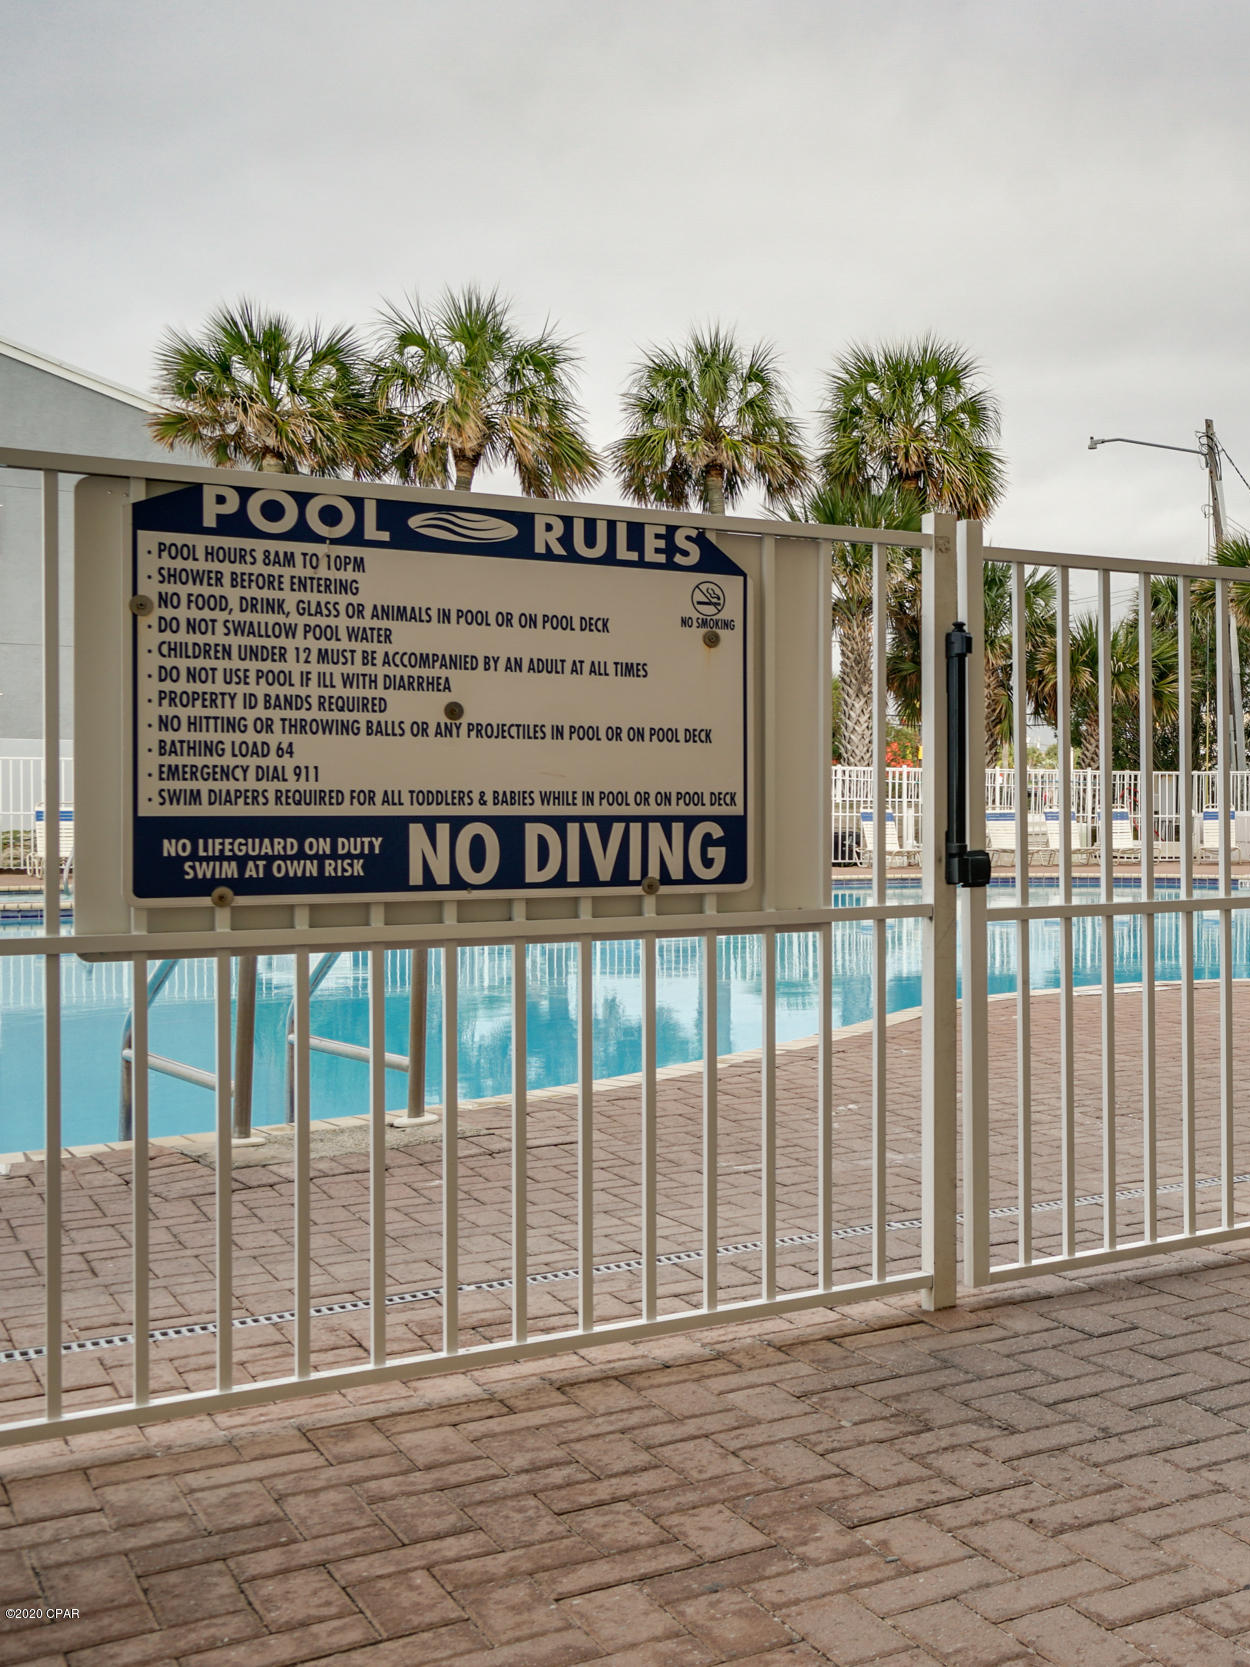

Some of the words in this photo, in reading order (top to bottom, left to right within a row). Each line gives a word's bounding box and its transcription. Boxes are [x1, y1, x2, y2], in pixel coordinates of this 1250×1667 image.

[203, 484, 391, 541] POOL
[534, 513, 702, 566] RULES
[158, 542, 199, 561] POOL
[205, 545, 256, 565] HOURS
[263, 550, 295, 568] 8AM
[301, 552, 319, 570] TO
[326, 555, 365, 573] 10PM
[158, 567, 223, 588] SHOWER
[231, 571, 284, 591] BEFORE
[290, 576, 359, 595] ENTERING
[158, 591, 181, 609] NO
[187, 593, 232, 615] FOOD,
[240, 597, 290, 618] DRINK,
[296, 600, 340, 618] GLASS
[346, 603, 364, 619] OR
[371, 604, 432, 623] ANIMALS
[438, 608, 450, 624] IN
[457, 610, 490, 626] POOL
[496, 612, 513, 628] OR
[519, 613, 537, 629] ON
[543, 614, 575, 631] POOL
[580, 616, 609, 633] DECK
[681, 616, 694, 629] NO
[696, 617, 736, 632] SMOKING
[158, 616, 180, 634] DO
[187, 618, 217, 635] NOT
[223, 619, 297, 639] SWALLOW
[304, 624, 341, 641] POOL
[346, 626, 392, 644] WATER
[158, 641, 232, 660] CHILDREN
[238, 644, 287, 662] UNDER
[295, 647, 311, 663] 12
[317, 649, 356, 666] MUST
[362, 650, 376, 666] BE
[382, 651, 478, 671] ACCOMPANIED
[484, 656, 499, 671] BY
[505, 657, 522, 673] AN
[528, 658, 566, 674] ADULT
[571, 660, 584, 675] AT
[589, 661, 609, 676] ALL
[614, 662, 648, 678] TIMES
[159, 665, 180, 683] DO
[187, 666, 217, 684] NOT
[224, 669, 249, 685] USE
[256, 670, 294, 687] POOL
[301, 671, 311, 687] IF
[318, 672, 336, 688] ILL
[341, 672, 377, 690] WITH
[384, 675, 451, 692] DIARRHEA
[159, 690, 237, 709] PROPERTY
[244, 693, 257, 709] ID
[264, 694, 312, 711] BANDS
[318, 695, 387, 712] REQUIRED
[159, 715, 181, 731] NO
[188, 716, 247, 733] HITTING
[254, 717, 273, 733] OR
[280, 718, 360, 736] THROWING
[367, 720, 405, 736] BALLS
[411, 721, 429, 737] OR
[435, 722, 462, 737] ANY
[468, 723, 546, 739] PROJECTILES
[552, 725, 564, 740] IN
[569, 726, 601, 740] POOL
[606, 727, 622, 741] OR
[628, 727, 644, 741] ON
[650, 727, 680, 743] POOL
[685, 728, 712, 743] DECK
[159, 739, 225, 757] BATHING
[232, 741, 270, 758] LOAD
[276, 742, 294, 758] 64
[159, 764, 249, 782] EMERGENCY
[256, 766, 288, 782] DIAL
[294, 766, 318, 782] 911
[158, 788, 202, 805] SWIM
[208, 789, 268, 806] DIAPERS
[275, 790, 344, 806] REQUIRED
[350, 790, 376, 806] FOR
[382, 790, 404, 805] ALL
[409, 790, 473, 805] TODDLERS
[479, 791, 487, 805] &
[493, 791, 534, 806] BABIES
[540, 791, 577, 806] WHILE
[582, 791, 594, 806] IN
[600, 791, 630, 806] POOL
[634, 792, 650, 806] OR
[655, 792, 671, 806] ON
[676, 792, 705, 806] POOL
[710, 792, 736, 806] DECK
[163, 839, 191, 856] NO
[199, 838, 297, 856] LIFEGUARD
[305, 838, 330, 854] ON
[338, 837, 382, 854] DUTY
[409, 822, 500, 886] NO
[525, 822, 727, 884] DIVING
[184, 861, 238, 879] SWIM
[245, 861, 266, 877] AT
[273, 860, 317, 877] OWN
[325, 860, 364, 876] RISK
